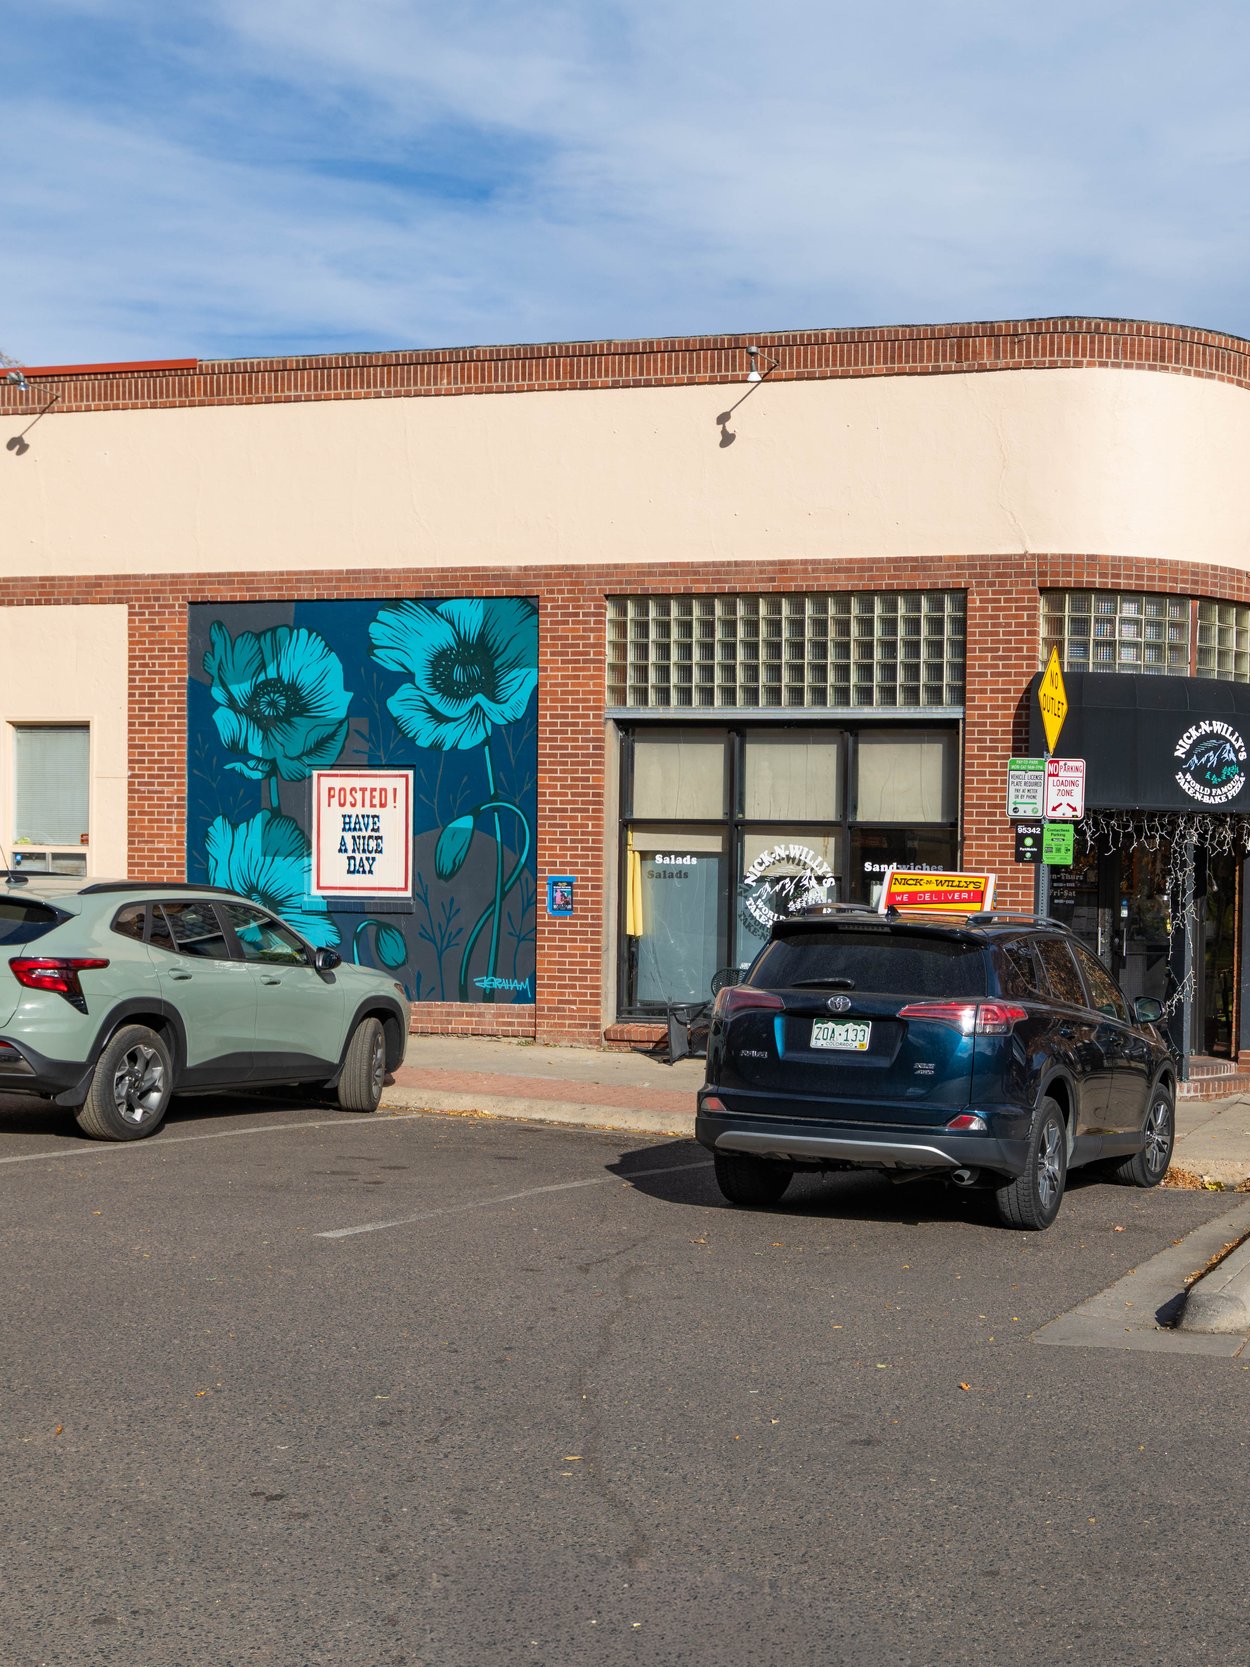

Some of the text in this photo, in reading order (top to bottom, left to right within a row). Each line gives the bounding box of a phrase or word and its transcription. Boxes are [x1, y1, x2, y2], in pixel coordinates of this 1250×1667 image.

[1050, 669, 1059, 690] NO
[1042, 693, 1065, 718] OUTLET
[1048, 763, 1082, 775] NO PARKING
[1052, 779, 1079, 787] LOADING
[1185, 772, 1239, 796] WORLD FAMOUS
[1227, 776, 1246, 800] PIZZA
[327, 786, 397, 809] POSTED!
[1056, 789, 1074, 797] ZONE
[341, 814, 380, 833] HAVE
[338, 835, 384, 854] A NICE
[346, 855, 376, 875] DAY
[655, 854, 697, 864] Salads
[864, 861, 944, 872] Sandwiches
[917, 892, 974, 901] DELIVER!
